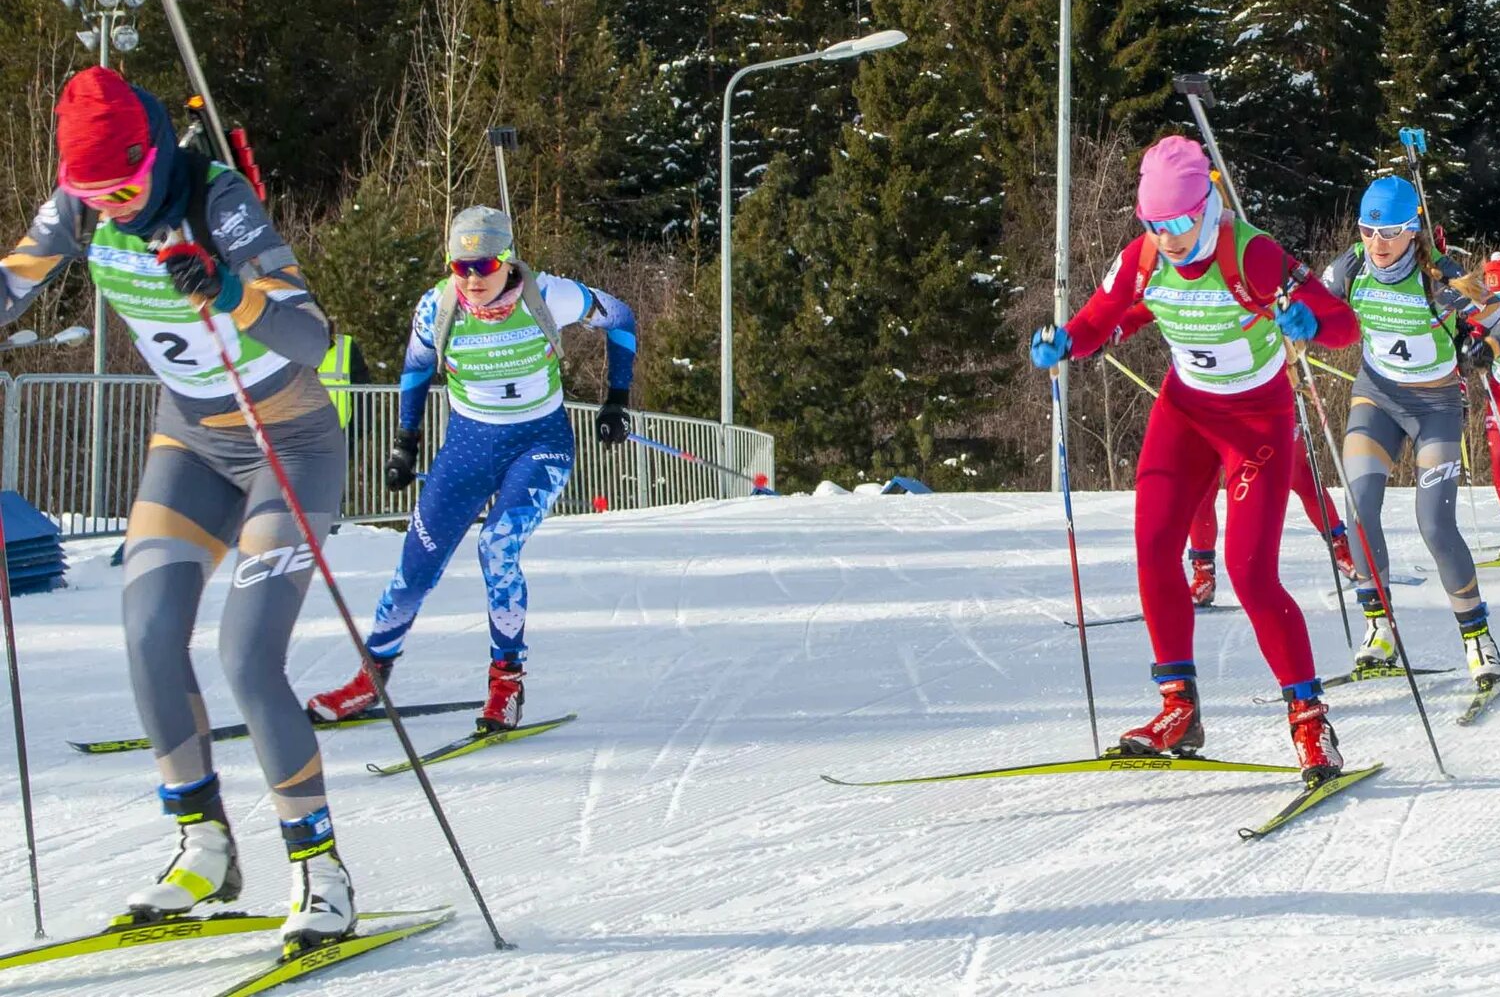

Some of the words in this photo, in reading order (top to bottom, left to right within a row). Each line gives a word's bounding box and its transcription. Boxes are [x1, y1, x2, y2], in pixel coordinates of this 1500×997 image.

[152, 331, 199, 366] 2
[1188, 349, 1218, 369] 5
[1388, 339, 1412, 362] 4
[500, 382, 522, 400] 1
[532, 453, 565, 461] CRAFT
[1233, 445, 1275, 502] odlo
[1153, 707, 1183, 734] alpina
[1109, 760, 1173, 770] FISCHER
[118, 923, 203, 947] FISCHER
[300, 946, 342, 971] FISCHER
